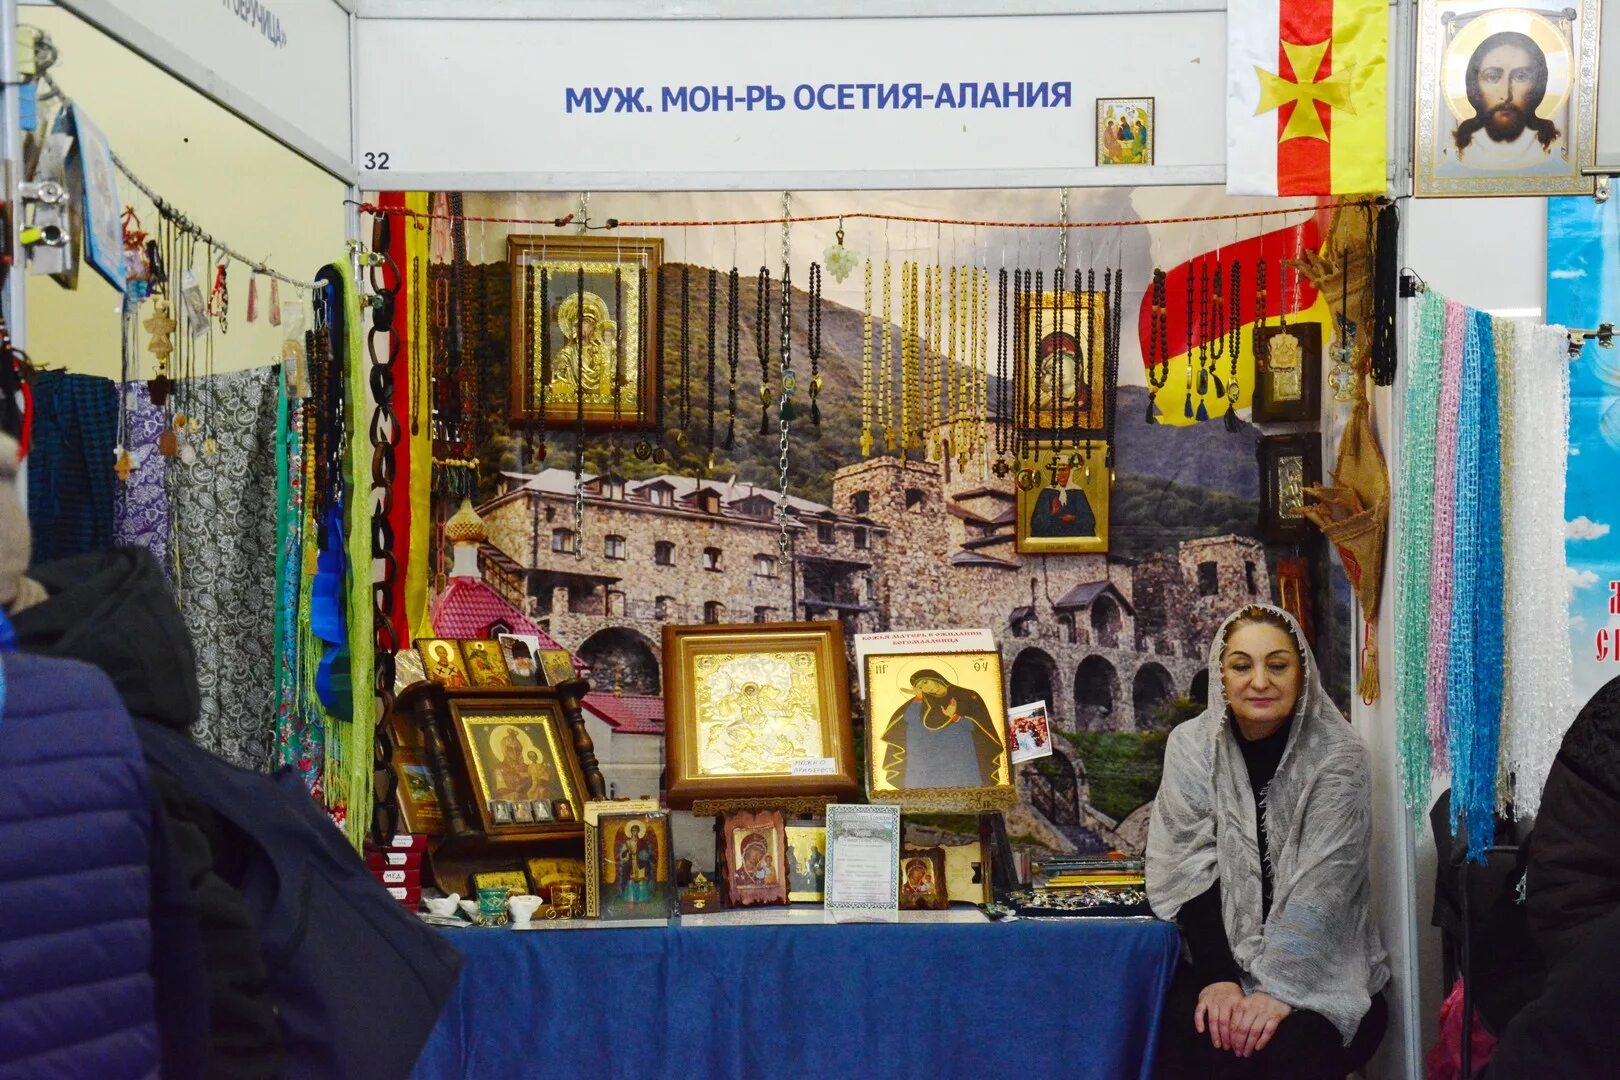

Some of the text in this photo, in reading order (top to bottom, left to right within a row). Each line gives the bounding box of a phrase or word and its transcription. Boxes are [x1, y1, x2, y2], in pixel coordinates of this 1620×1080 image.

[565, 82, 1072, 113] МУЖ. МОН-РЬ ОСЕТИЯ-АЛАНИЯ
[364, 152, 389, 170] 32
